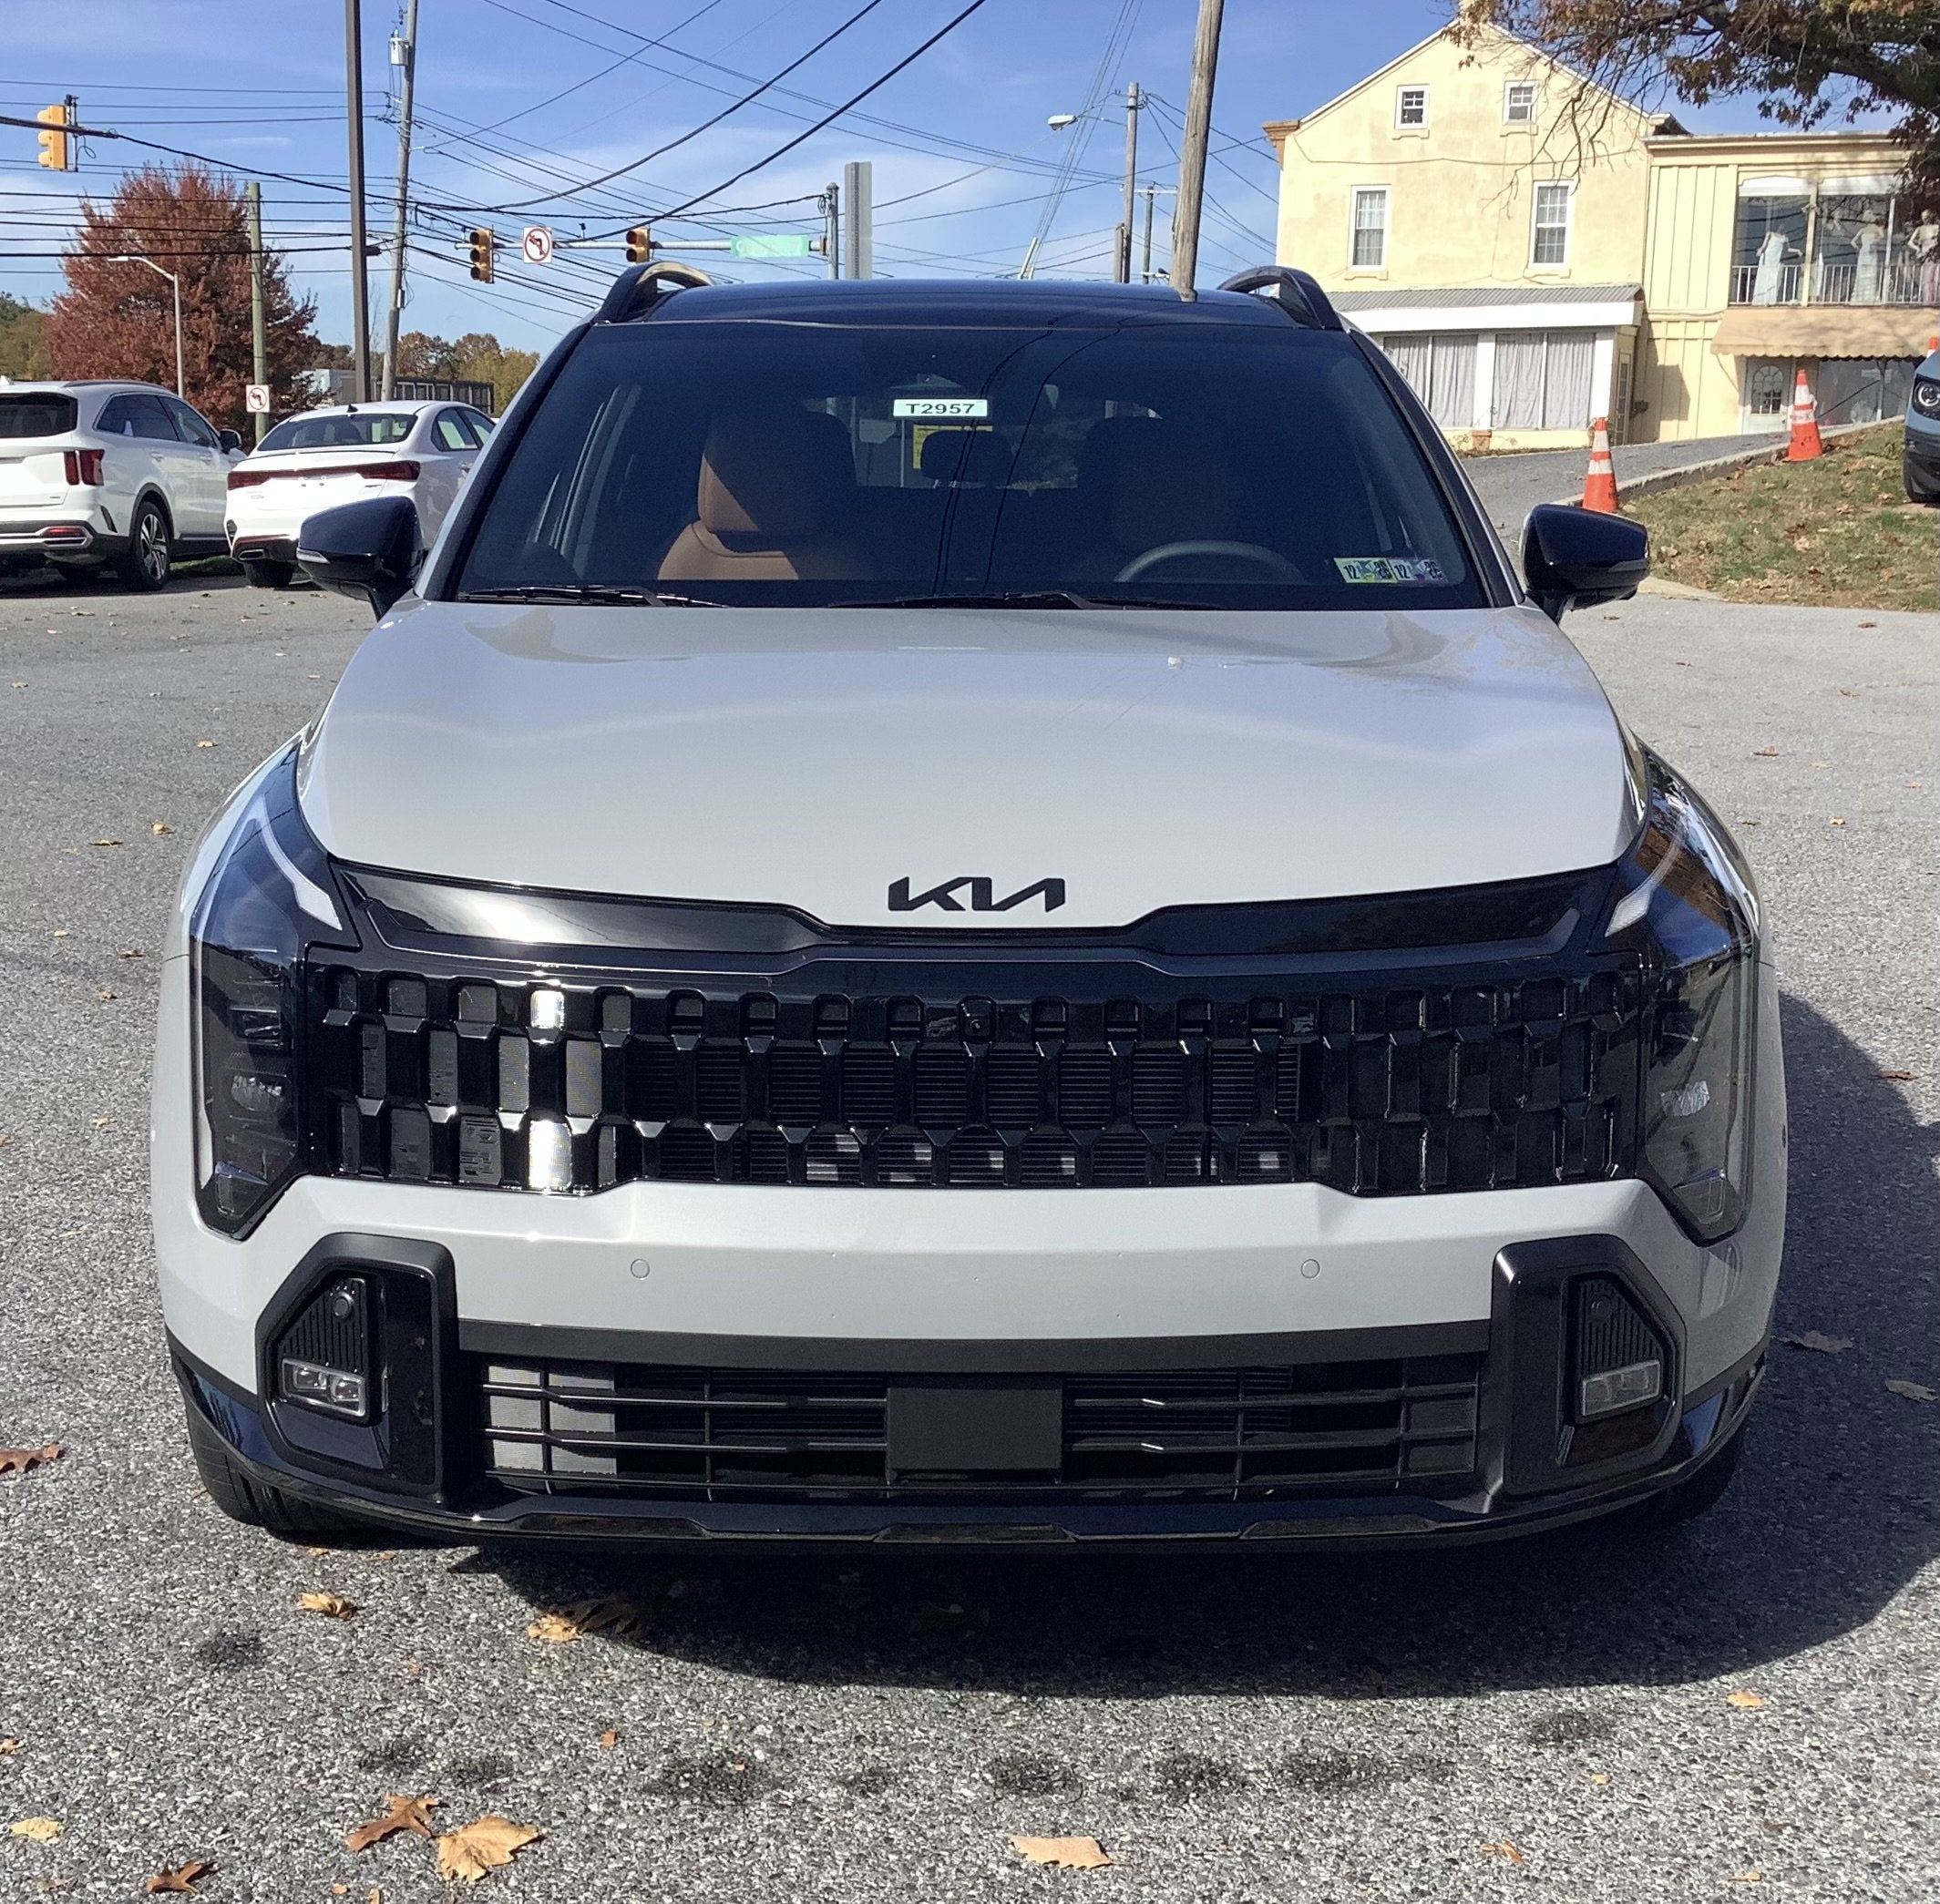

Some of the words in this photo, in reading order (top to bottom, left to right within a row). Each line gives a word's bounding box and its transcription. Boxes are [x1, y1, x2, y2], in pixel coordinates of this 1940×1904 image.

[906, 404, 975, 415] T2957
[1343, 564, 1360, 579] 12
[1394, 564, 1411, 579] 12
[888, 875, 1066, 913] KIA
